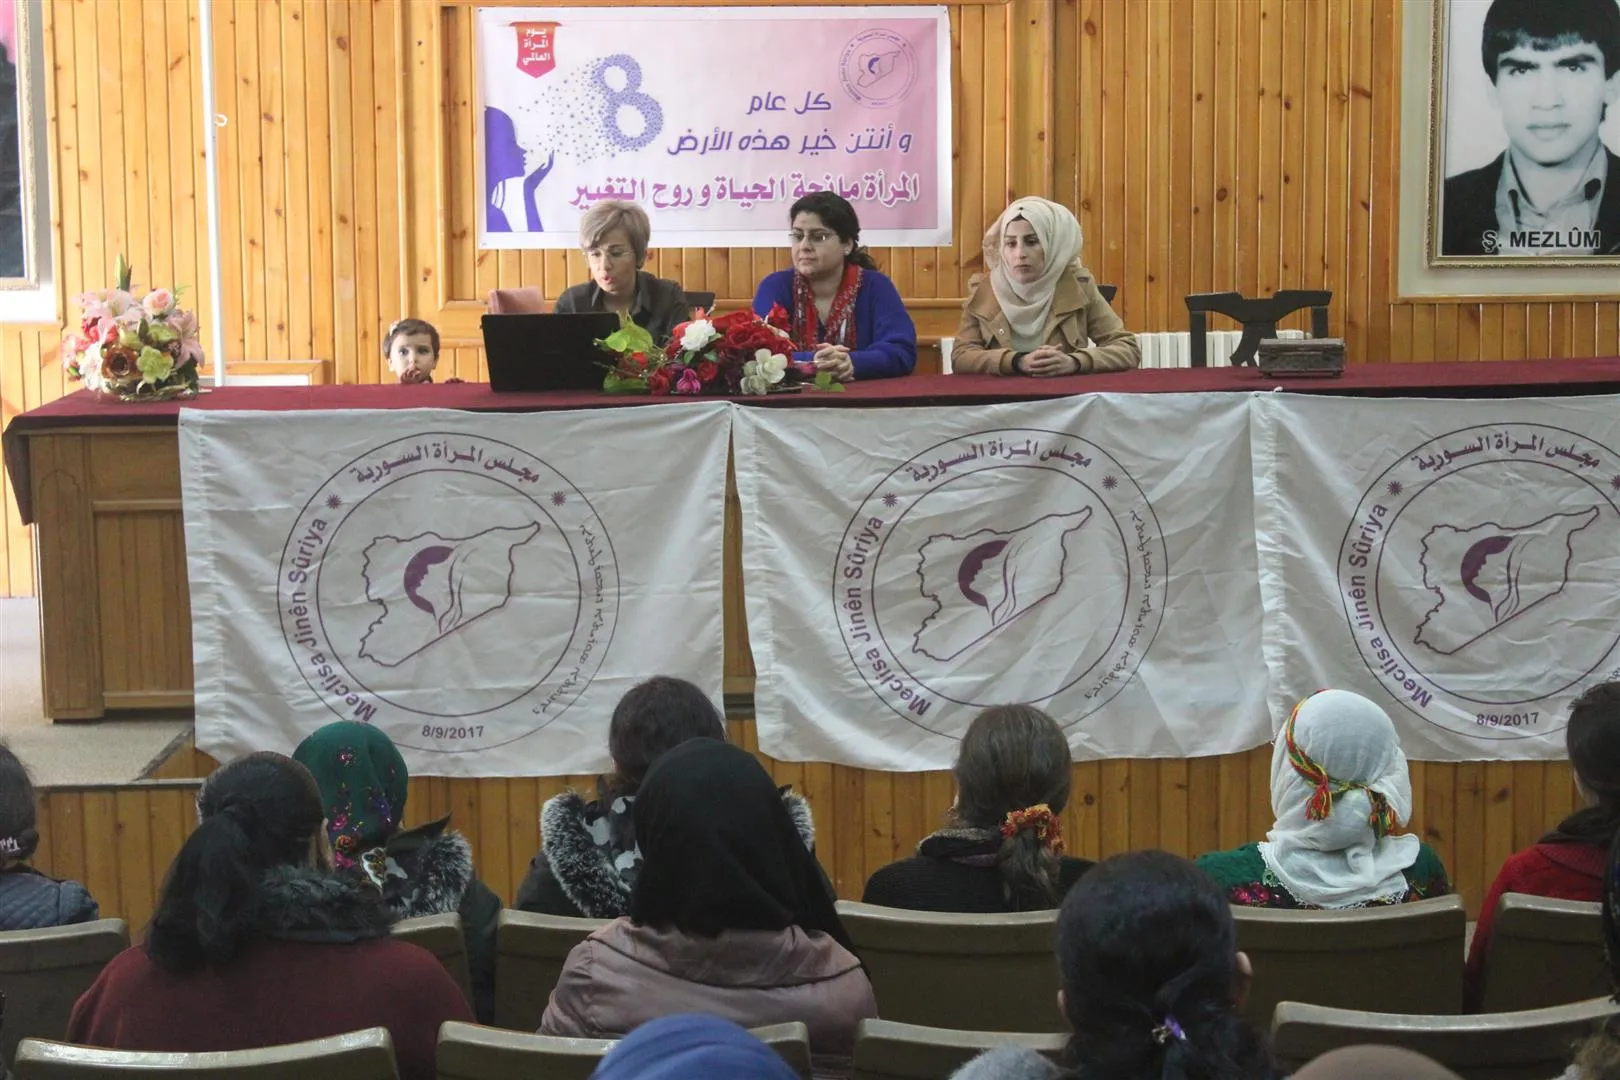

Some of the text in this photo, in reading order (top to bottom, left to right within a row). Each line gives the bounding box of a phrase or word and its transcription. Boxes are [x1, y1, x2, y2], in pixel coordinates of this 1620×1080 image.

[746, 91, 832, 116] كل عام
[667, 126, 733, 156] الأرض
[738, 128, 790, 152] هذه
[798, 128, 837, 156] خير
[715, 175, 785, 208] الحياة
[865, 170, 919, 205] المرأة
[1509, 227, 1601, 249] MEZLÛM
[349, 440, 540, 484] مجلس المرأة السورية
[904, 437, 1093, 483] مجلس المرأة السورية
[1410, 430, 1601, 472] مجلس المرأة السورية
[288, 518, 378, 722] Meclisa Jinên Sûriya
[843, 516, 932, 716] Meclisa Jinên Sûriya
[1348, 503, 1433, 708] Meclisa Jinên Sûriya
[422, 725, 485, 739] 8/9/2017
[1476, 711, 1540, 727] 8/9/2017
